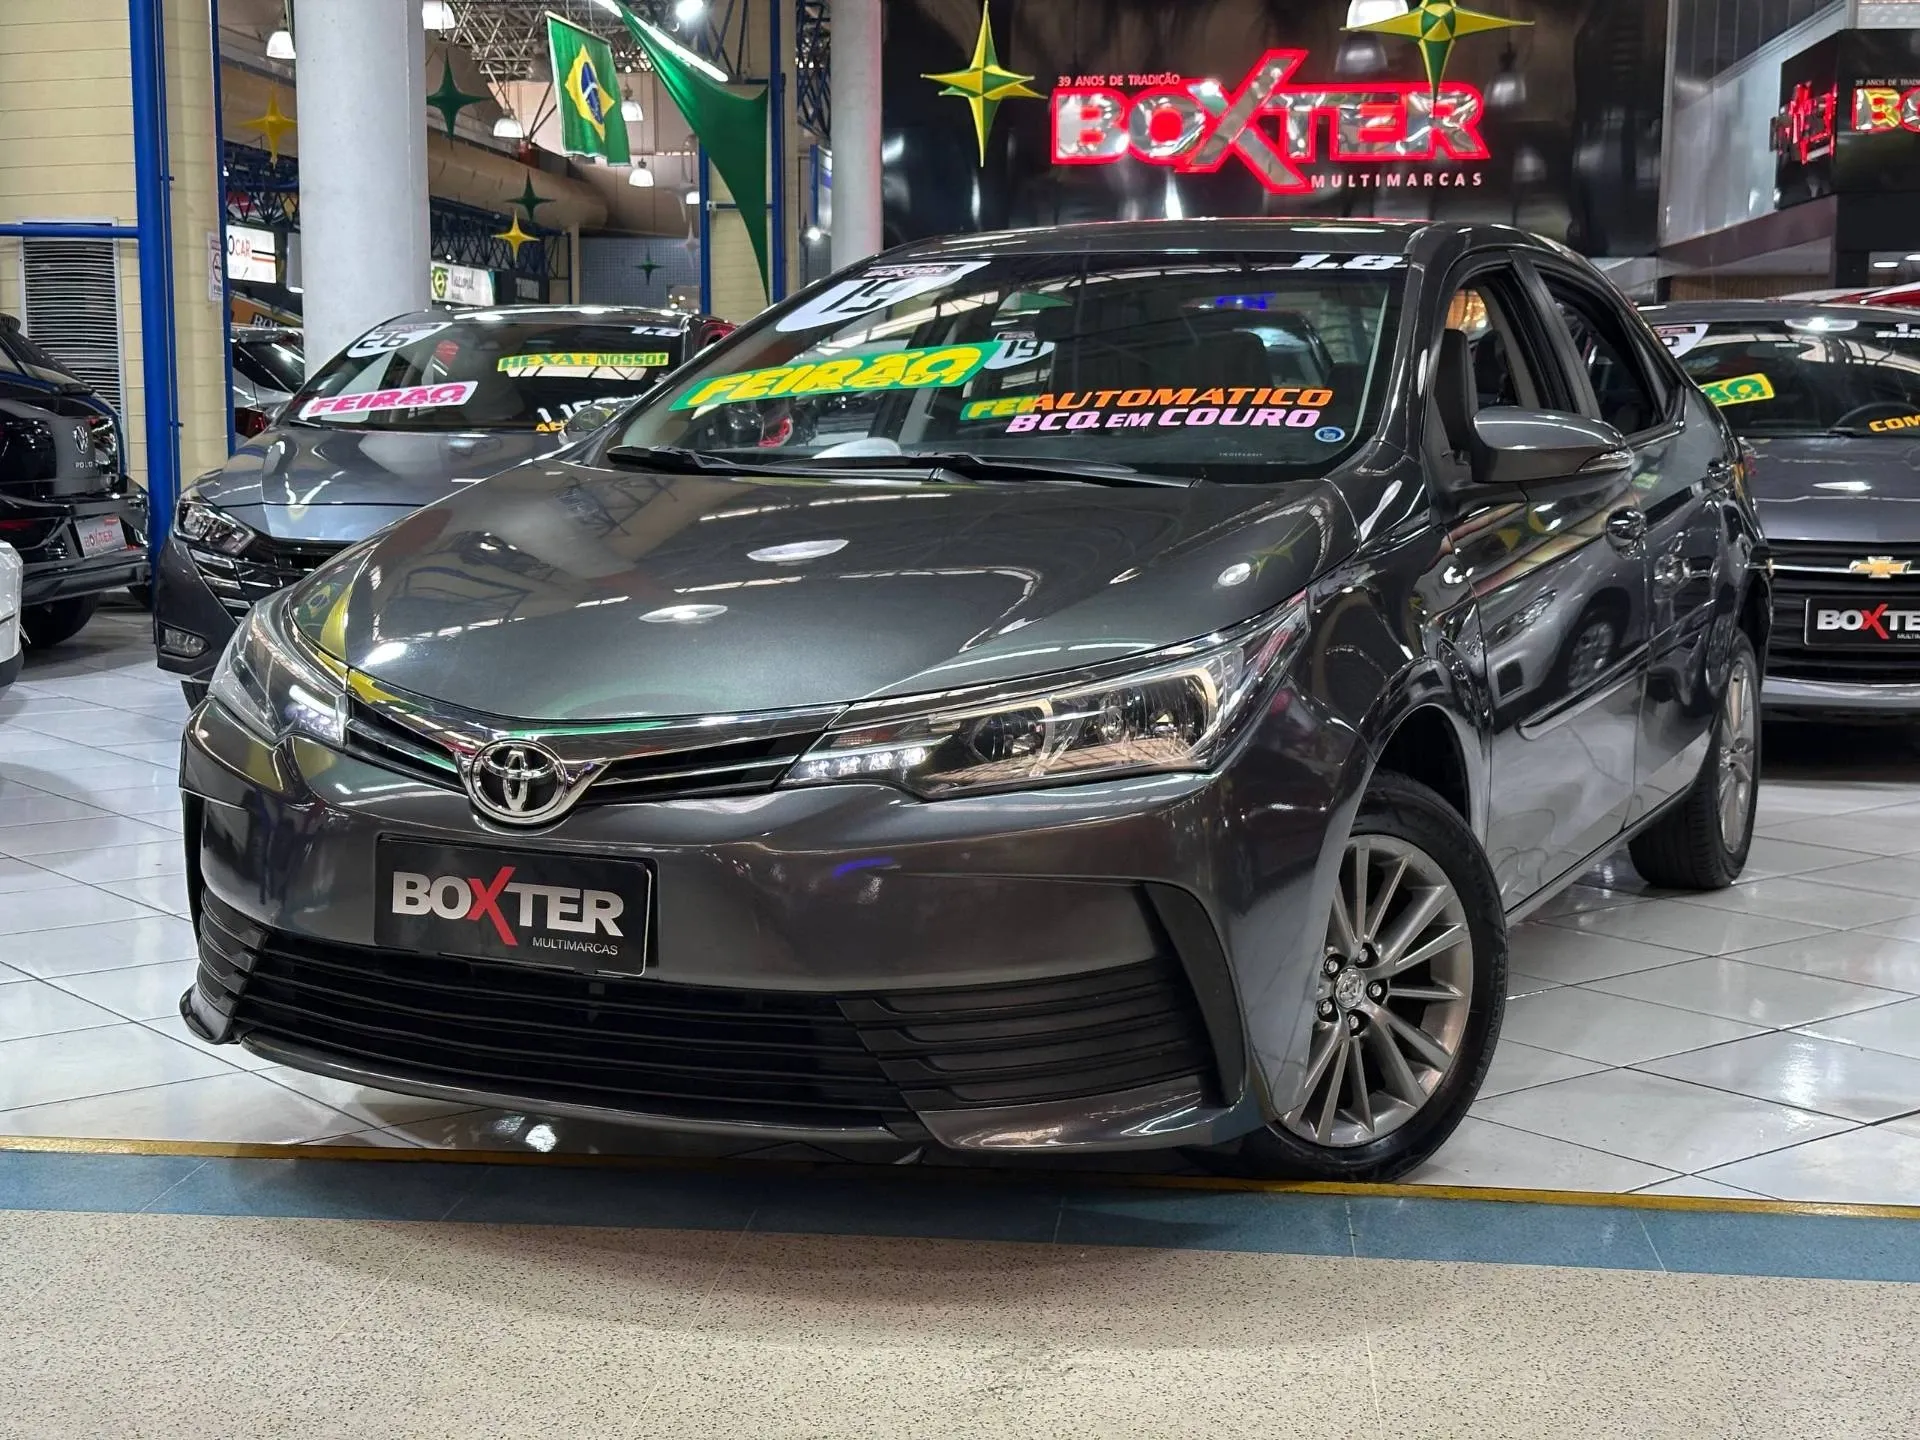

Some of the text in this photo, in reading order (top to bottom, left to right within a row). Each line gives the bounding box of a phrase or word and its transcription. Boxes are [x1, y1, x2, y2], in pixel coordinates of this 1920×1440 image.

[1058, 72, 1180, 87] 39 ANOS DE TRADIÇÃO
[1051, 49, 1491, 194] BOXTER
[1311, 172, 1482, 189] MULTIMARCAS
[1291, 253, 1403, 270] 1.8
[354, 331, 410, 349] 26
[1003, 340, 1045, 359] 19
[500, 353, 571, 369] HEXA
[688, 347, 981, 405] FEIRÃO
[307, 384, 468, 415] FEIRÃO
[1105, 413, 1155, 428] EM
[1158, 408, 1321, 428] COURO
[75, 460, 93, 469] POLO
[392, 866, 624, 946] BOXTER
[532, 936, 618, 955] MULTIMARCAS
